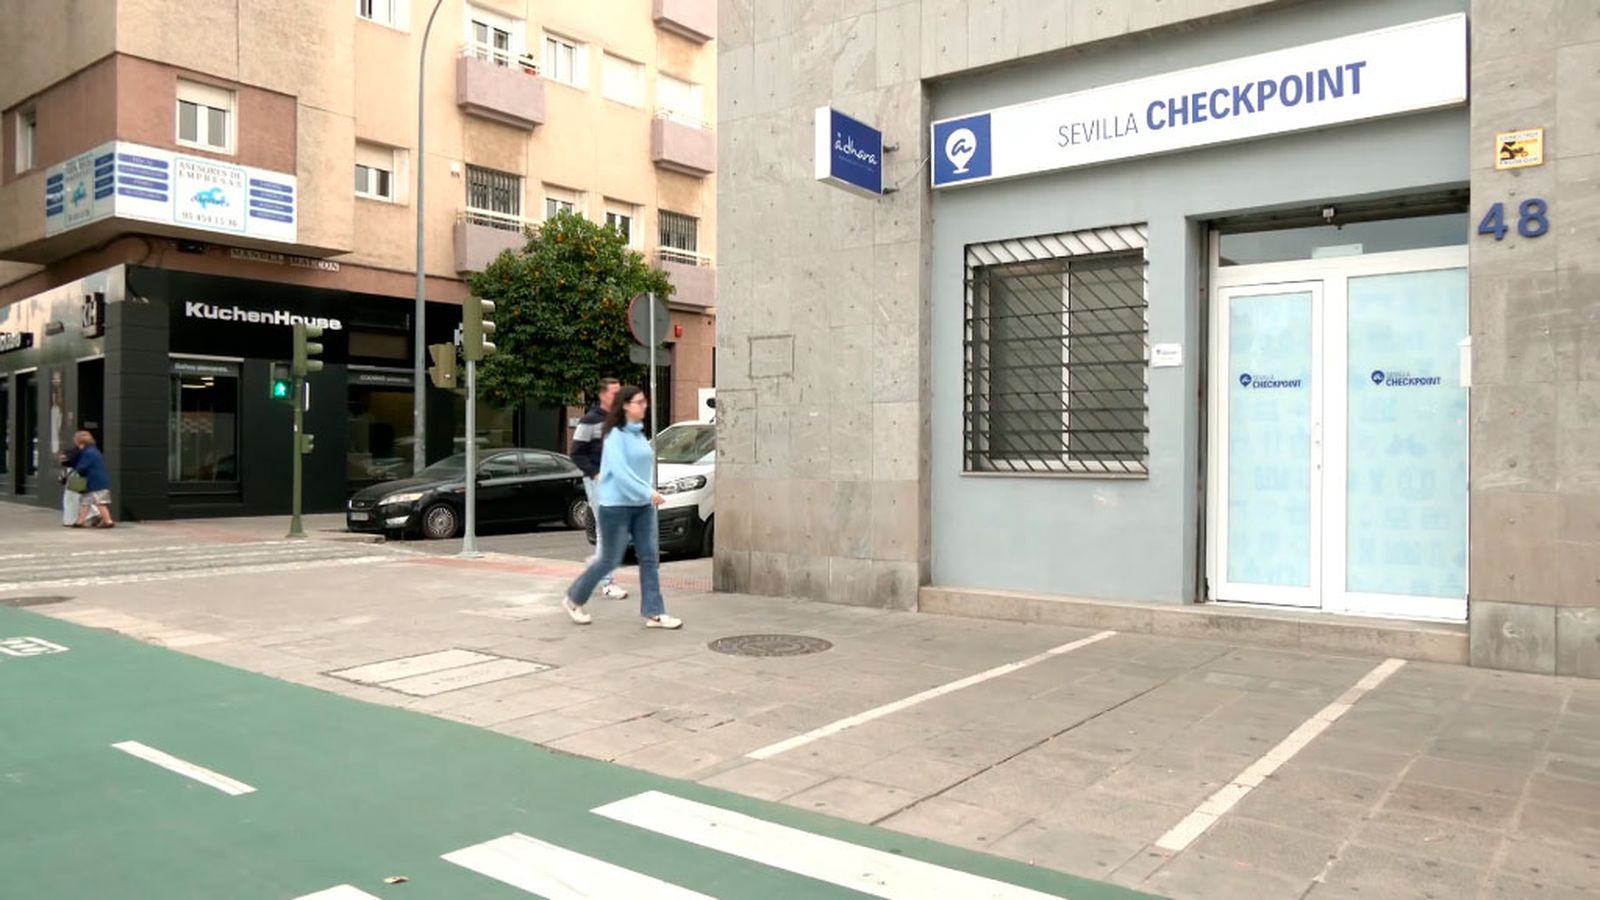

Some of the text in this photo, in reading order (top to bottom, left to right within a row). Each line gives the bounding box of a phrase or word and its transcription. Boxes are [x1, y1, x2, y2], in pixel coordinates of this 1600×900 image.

[1057, 60, 1367, 148] SEVILLA CHECKPOINT
[178, 161, 228, 177] ASESORES
[178, 169, 242, 188] EMPRESAS
[1478, 198, 1549, 241] 48
[1252, 379, 1301, 389] CHECKPOINT
[1385, 376, 1442, 387] CHECKPOINT
